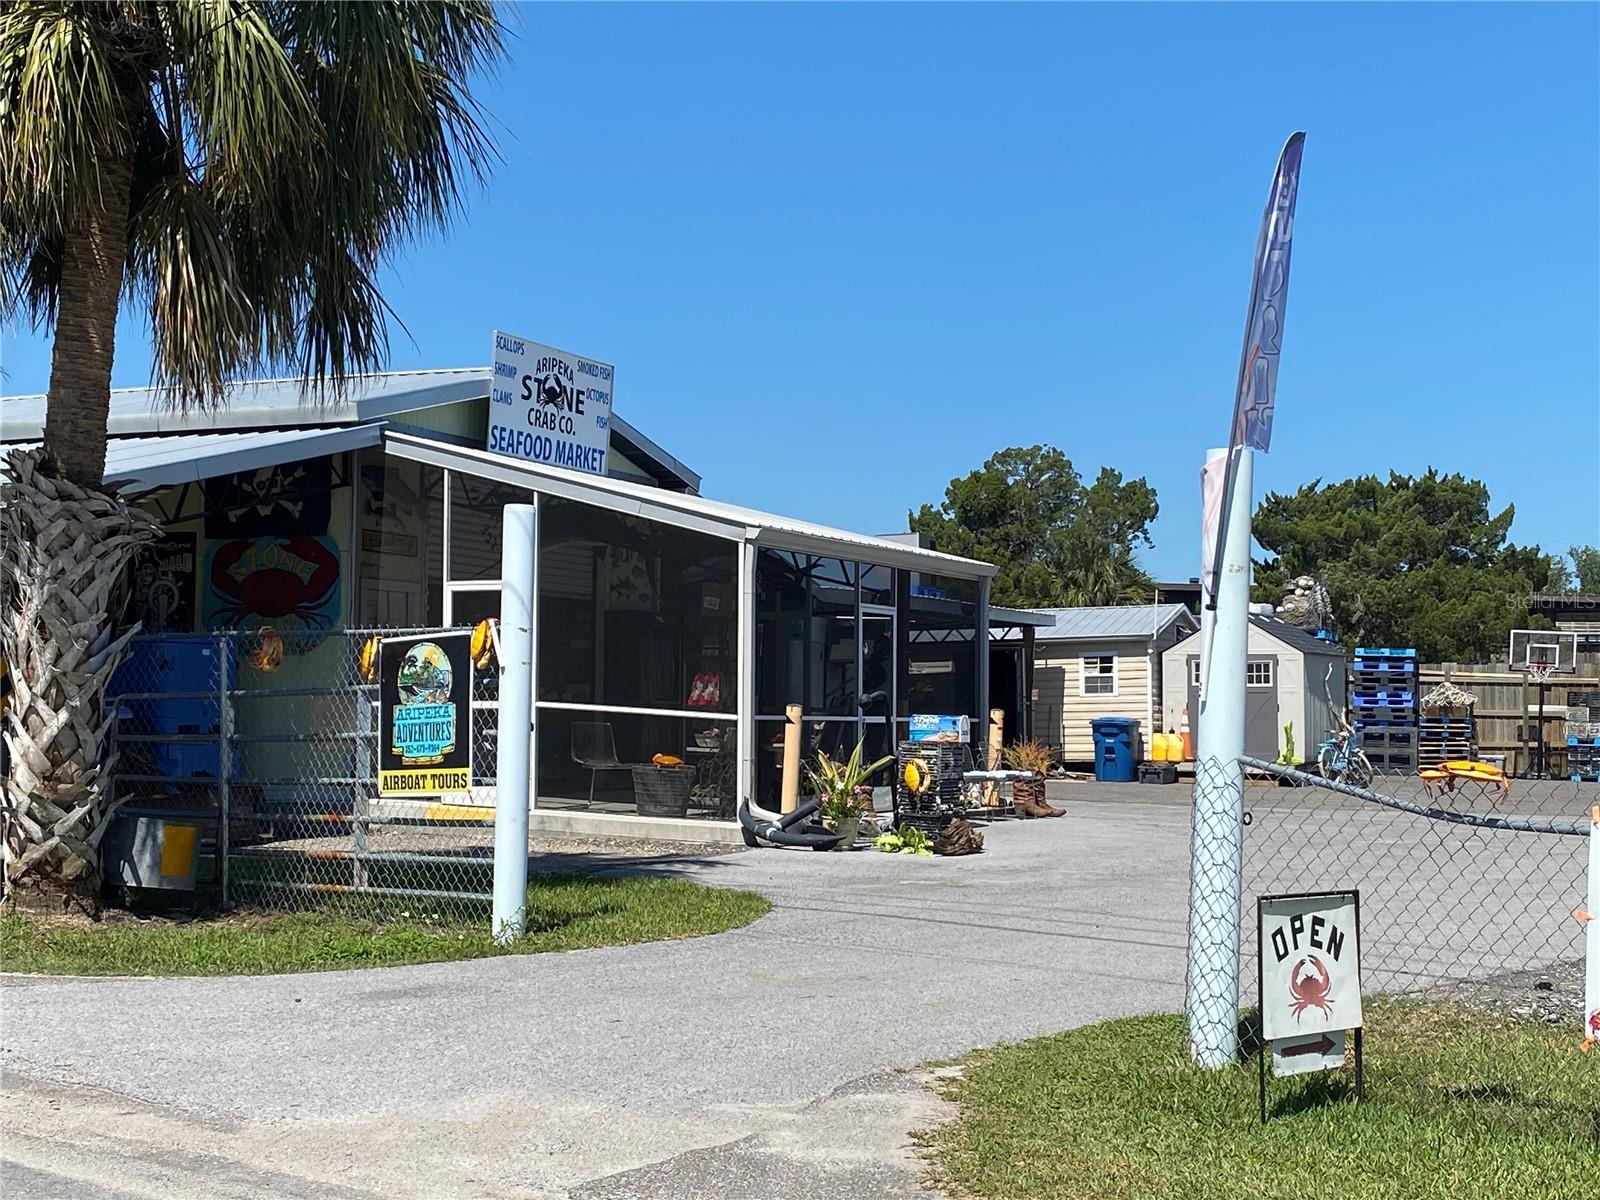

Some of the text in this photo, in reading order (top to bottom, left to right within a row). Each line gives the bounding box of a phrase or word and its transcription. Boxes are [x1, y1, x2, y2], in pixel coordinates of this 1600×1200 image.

[496, 335, 525, 355] SCALLOPS
[494, 361, 517, 379] SHRIMP
[535, 357, 574, 385] ARIPEKA
[577, 360, 611, 381] SMOKED FISH
[492, 388, 513, 406] CLAMS
[586, 387, 610, 405] OCTOPUS
[527, 408, 576, 436] CRAB CO.
[596, 415, 608, 430] FISH
[490, 424, 605, 473] SEAFOOD MARKET
[397, 706, 451, 721] ARIPEKA
[397, 721, 451, 743] ADVENTURES
[382, 773, 468, 791] AIRBOAT TOURS
[1271, 913, 1345, 963] OPEN
